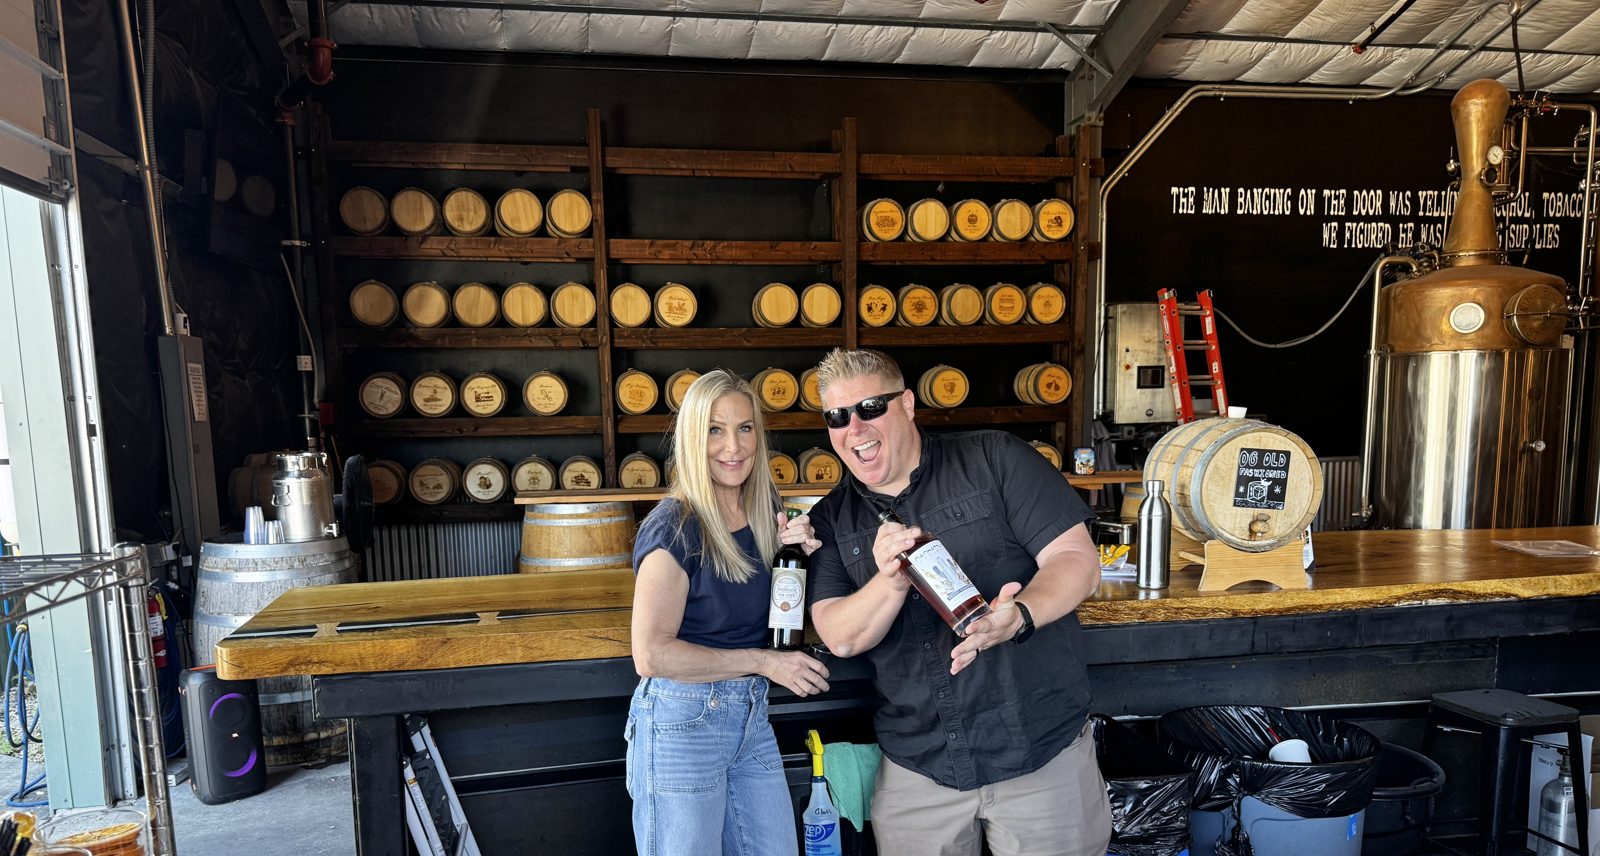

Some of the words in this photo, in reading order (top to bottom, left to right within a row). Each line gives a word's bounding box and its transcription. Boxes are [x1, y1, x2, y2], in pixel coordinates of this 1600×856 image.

[1171, 186, 1196, 214] THE
[1202, 186, 1230, 215] MAN
[1236, 187, 1292, 215] BANGING
[1298, 188, 1316, 215] ON
[1323, 189, 1346, 216] THE
[1352, 189, 1383, 216] DOOR
[1389, 190, 1411, 216] WAS
[1418, 190, 1460, 217] YELLIN
[1542, 192, 1585, 217] TOBACC
[1322, 222, 1338, 248] WE
[1343, 222, 1392, 248] FIGURED
[1398, 223, 1415, 248] HE
[1420, 223, 1442, 248] WAS
[1239, 451, 1258, 467] OG
[1263, 452, 1287, 467] OLD
